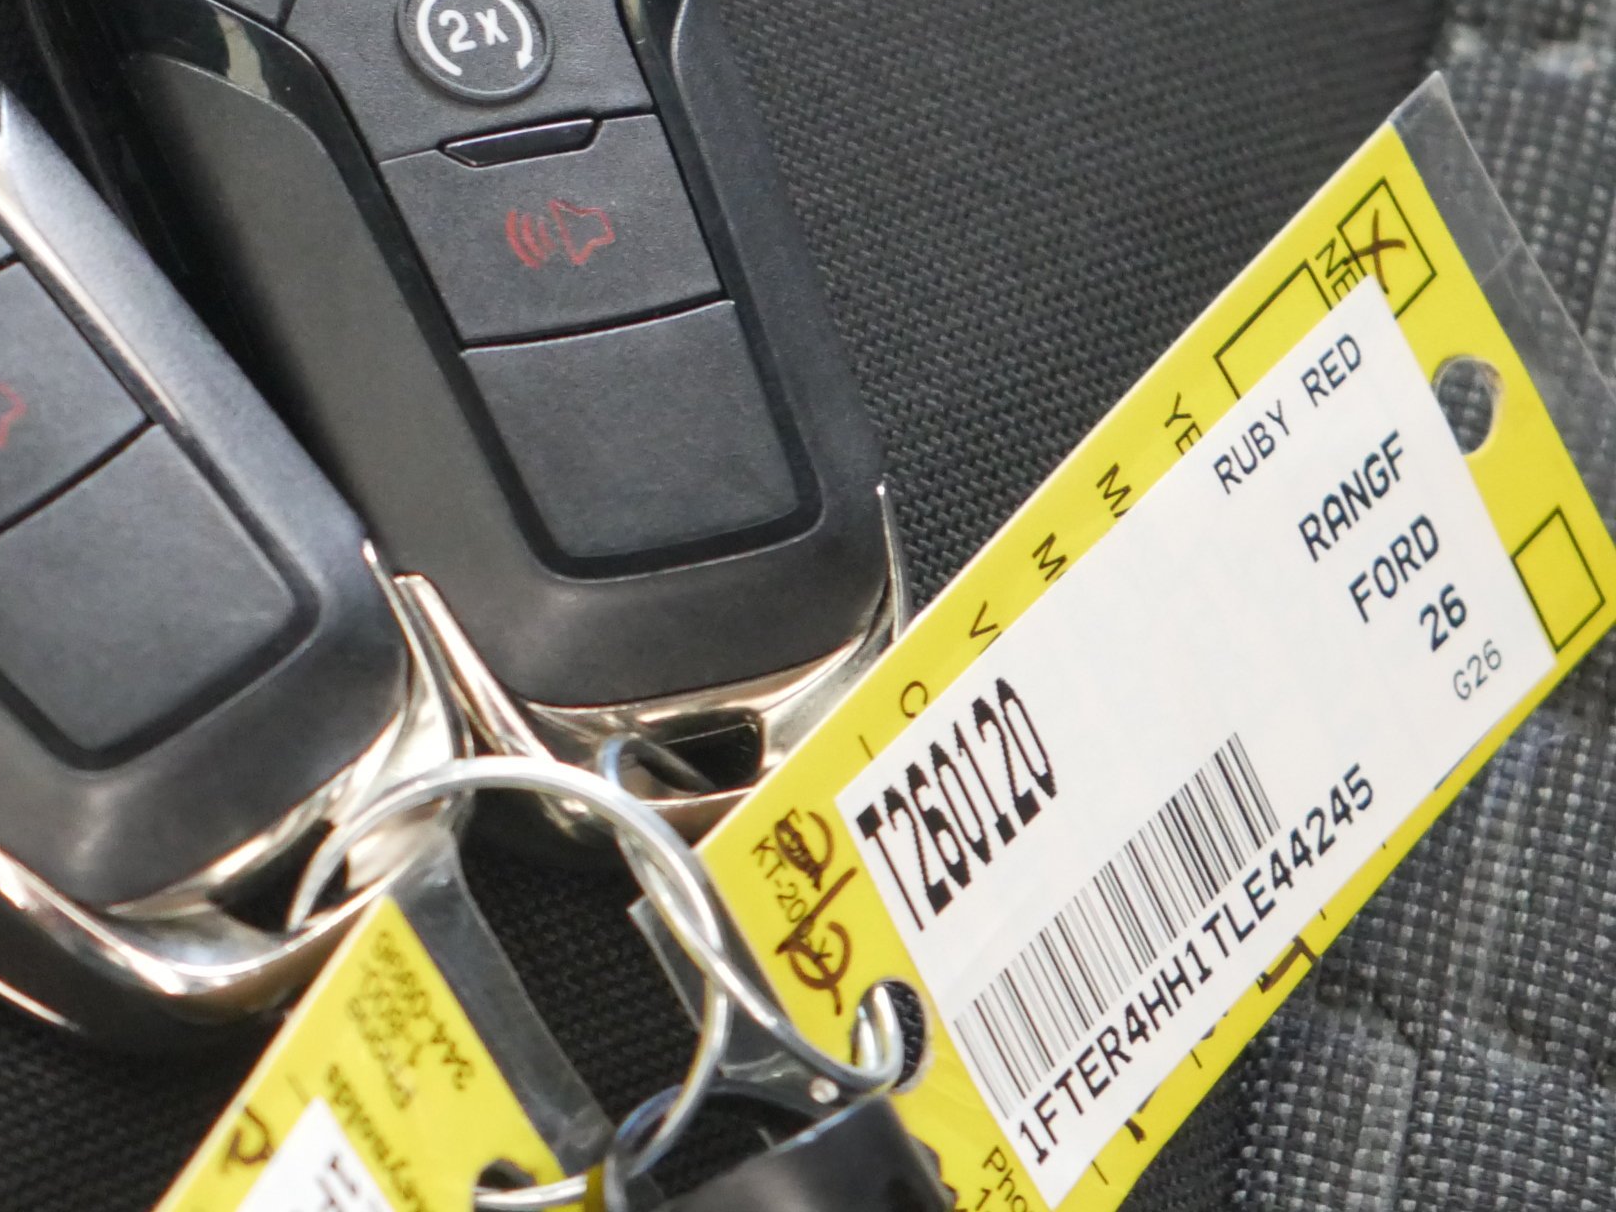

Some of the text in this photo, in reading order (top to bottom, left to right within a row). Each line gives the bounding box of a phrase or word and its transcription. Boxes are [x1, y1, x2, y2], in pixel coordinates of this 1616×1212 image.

[1315, 237, 1359, 302] NE
[1164, 392, 1203, 455] YE
[1213, 399, 1290, 494] RUBY
[1301, 334, 1361, 407] RED
[1298, 430, 1403, 563] RANGF
[1348, 514, 1439, 623] FORD
[1419, 583, 1467, 652] 26
[1452, 639, 1502, 700] G26
[856, 677, 1057, 931] T260120
[1018, 763, 1374, 1165] 1FTER4HH1TLE44245
[981, 1145, 1028, 1212] Pho
